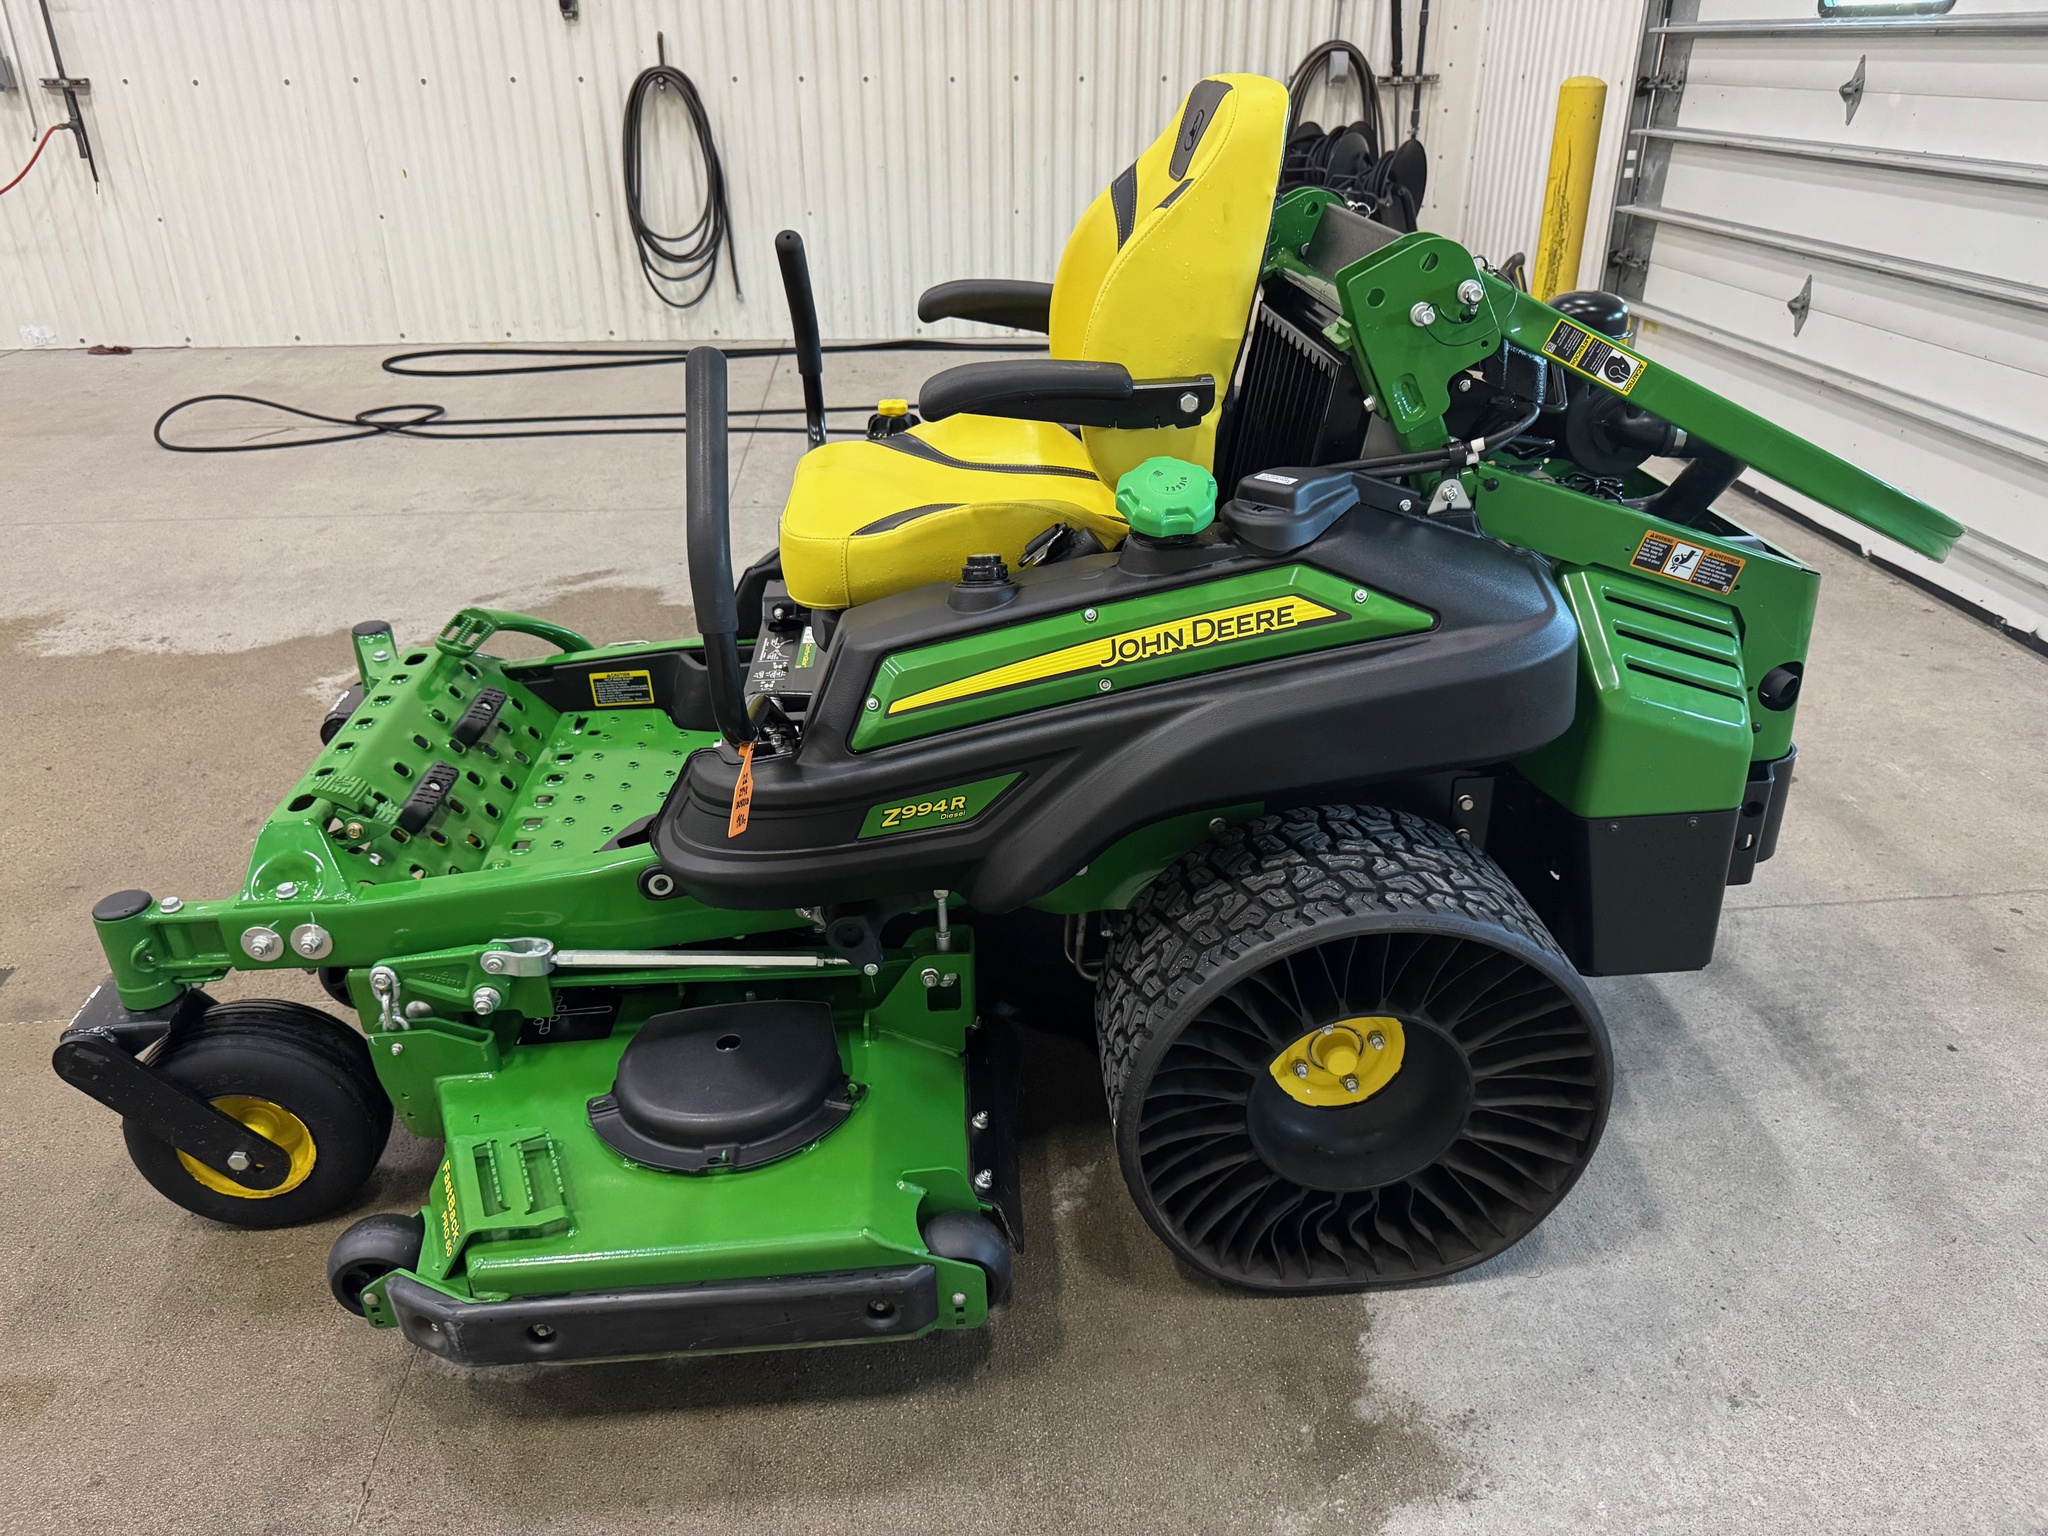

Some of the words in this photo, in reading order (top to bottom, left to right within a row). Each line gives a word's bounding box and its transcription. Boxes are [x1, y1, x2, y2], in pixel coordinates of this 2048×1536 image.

[1624, 368, 1643, 393] CAUTION
[1165, 476, 1188, 492] DIESEL
[1101, 628, 1183, 664] JOHN
[1192, 604, 1295, 644] DEERE
[940, 810, 966, 820] Diesel
[442, 1159, 460, 1243] FastBack
[442, 1210, 450, 1240] PRO
[446, 1239, 453, 1258] 60
